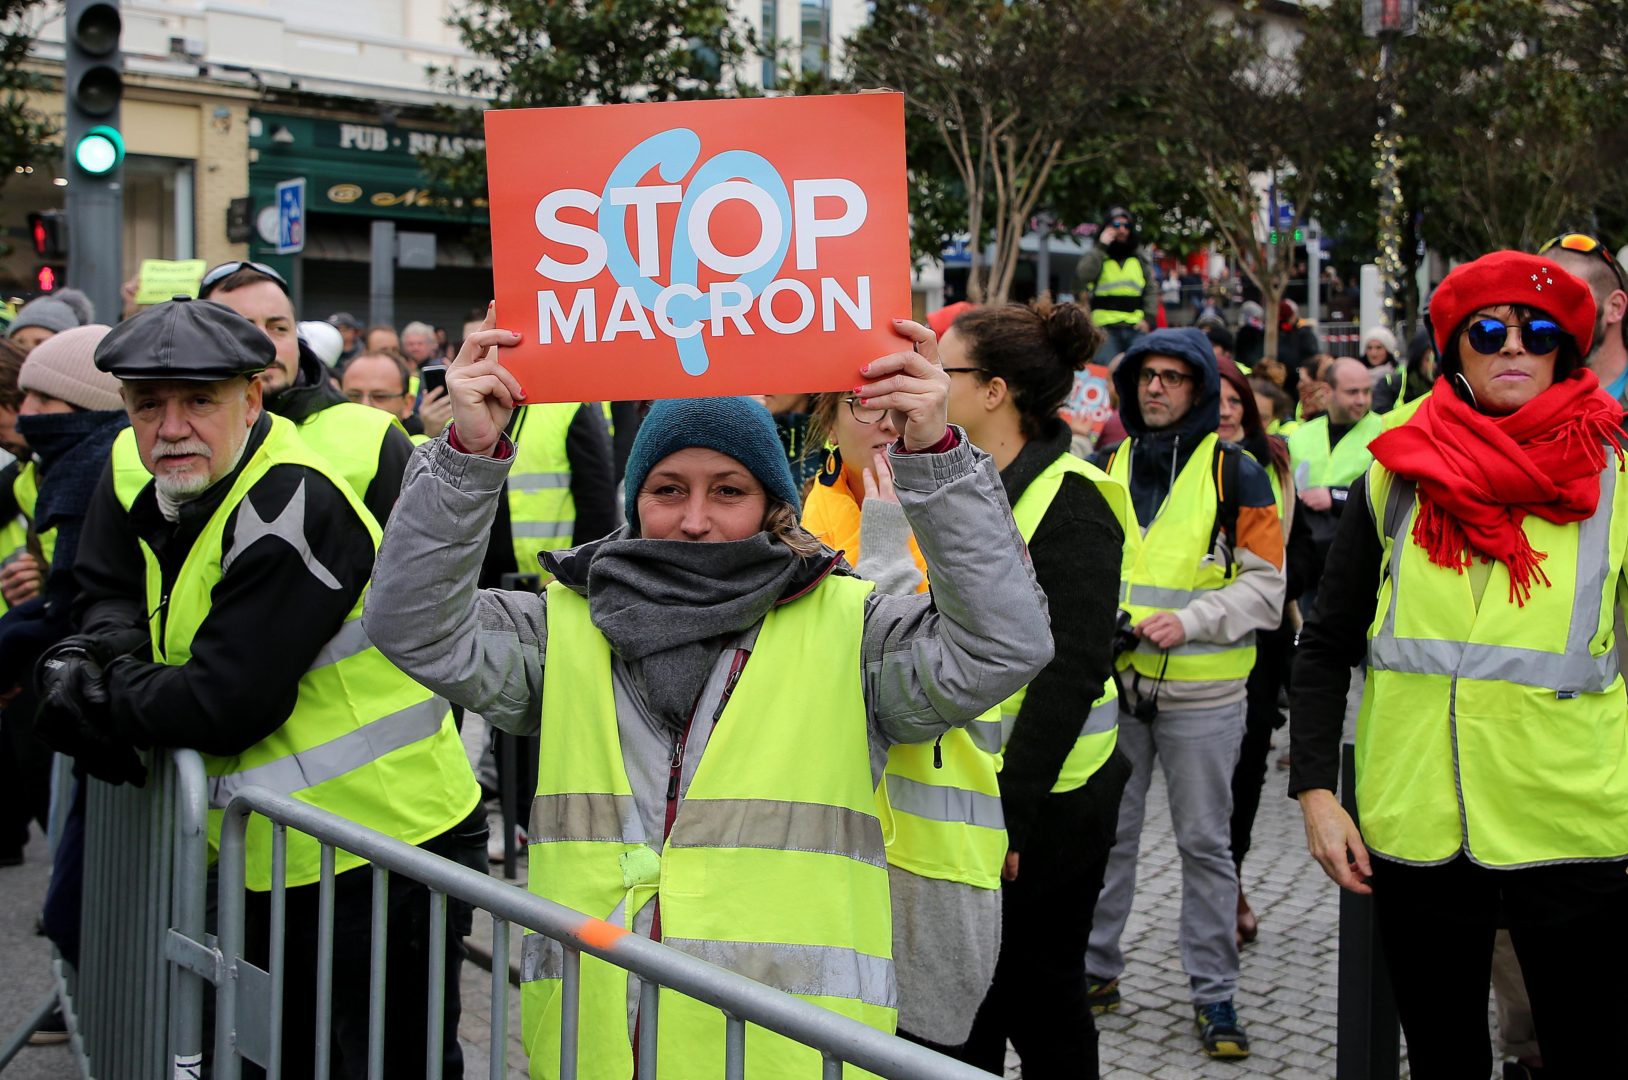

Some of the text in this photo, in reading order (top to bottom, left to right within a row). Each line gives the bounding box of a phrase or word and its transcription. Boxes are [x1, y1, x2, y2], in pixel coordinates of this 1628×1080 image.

[340, 123, 388, 151] PUB
[534, 178, 868, 283] STOP
[536, 275, 873, 345] MACRON
